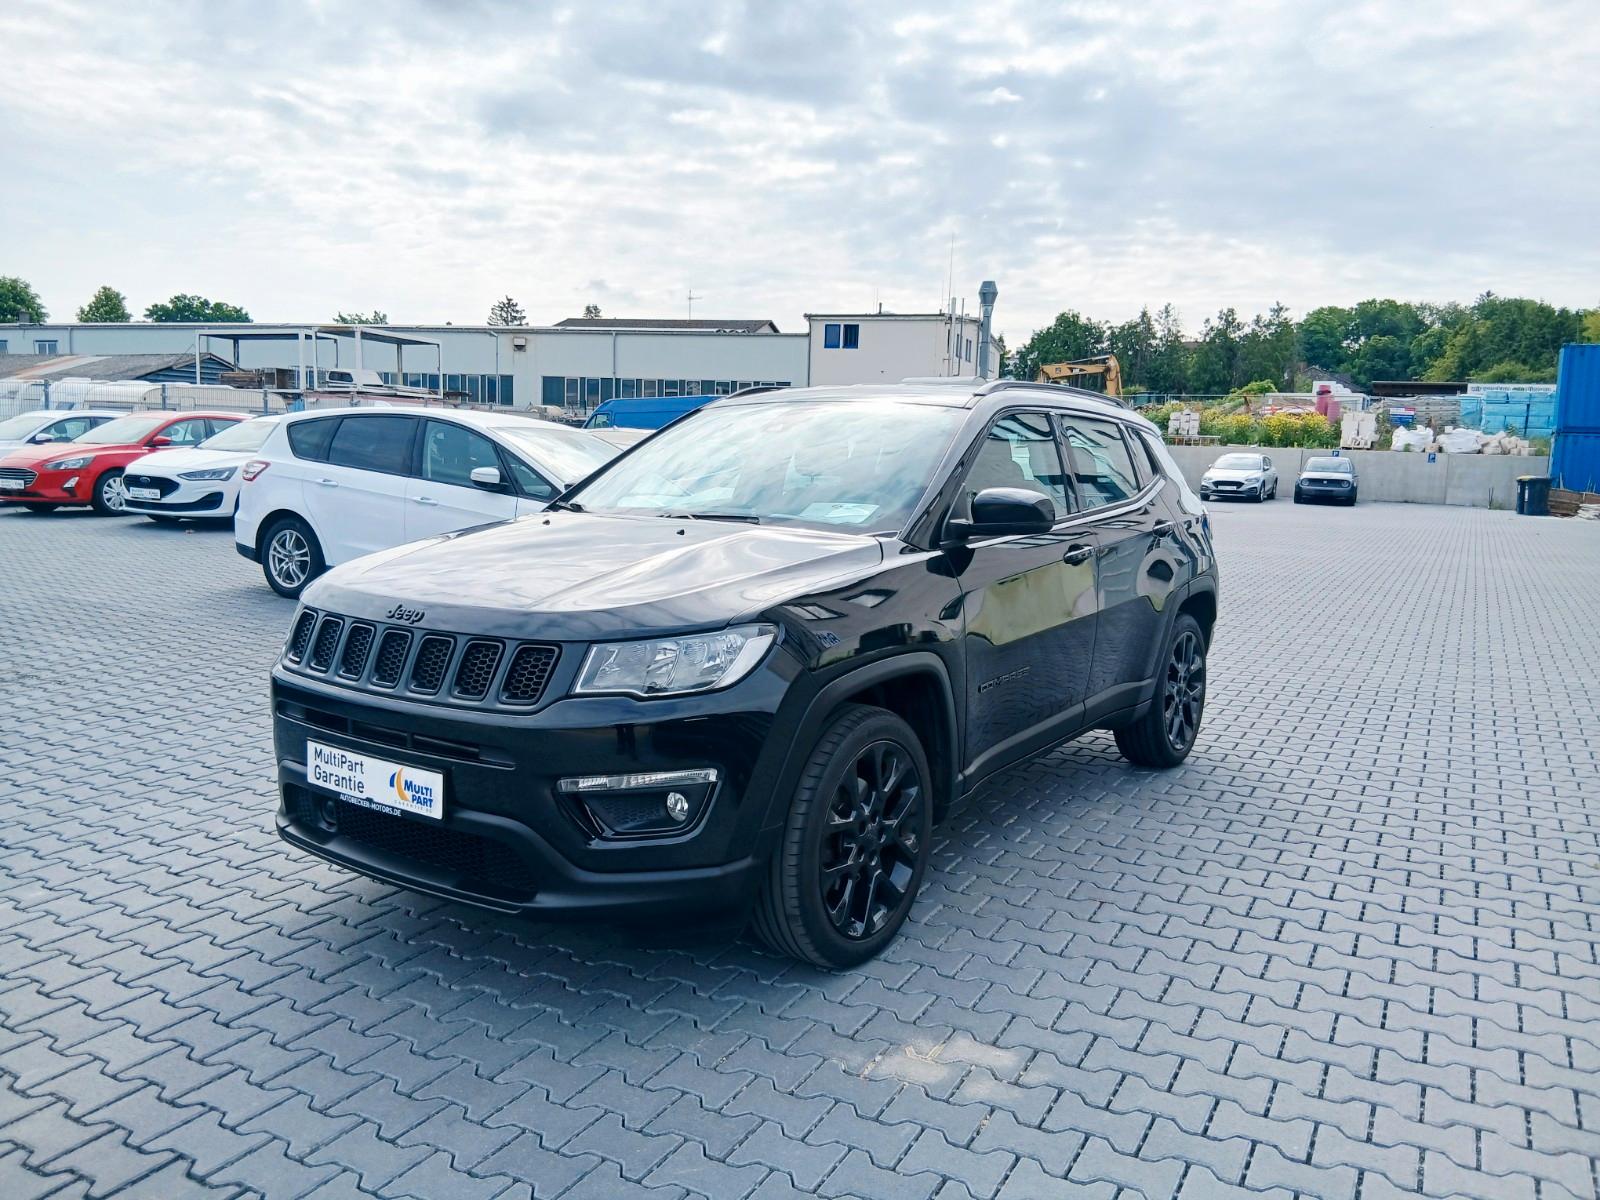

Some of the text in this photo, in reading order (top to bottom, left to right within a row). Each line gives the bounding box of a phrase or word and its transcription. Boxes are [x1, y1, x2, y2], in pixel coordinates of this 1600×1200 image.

[386, 604, 425, 625] Jeep
[314, 746, 364, 774] MultiPart
[314, 764, 365, 793] Garantie
[411, 794, 434, 809] PART
